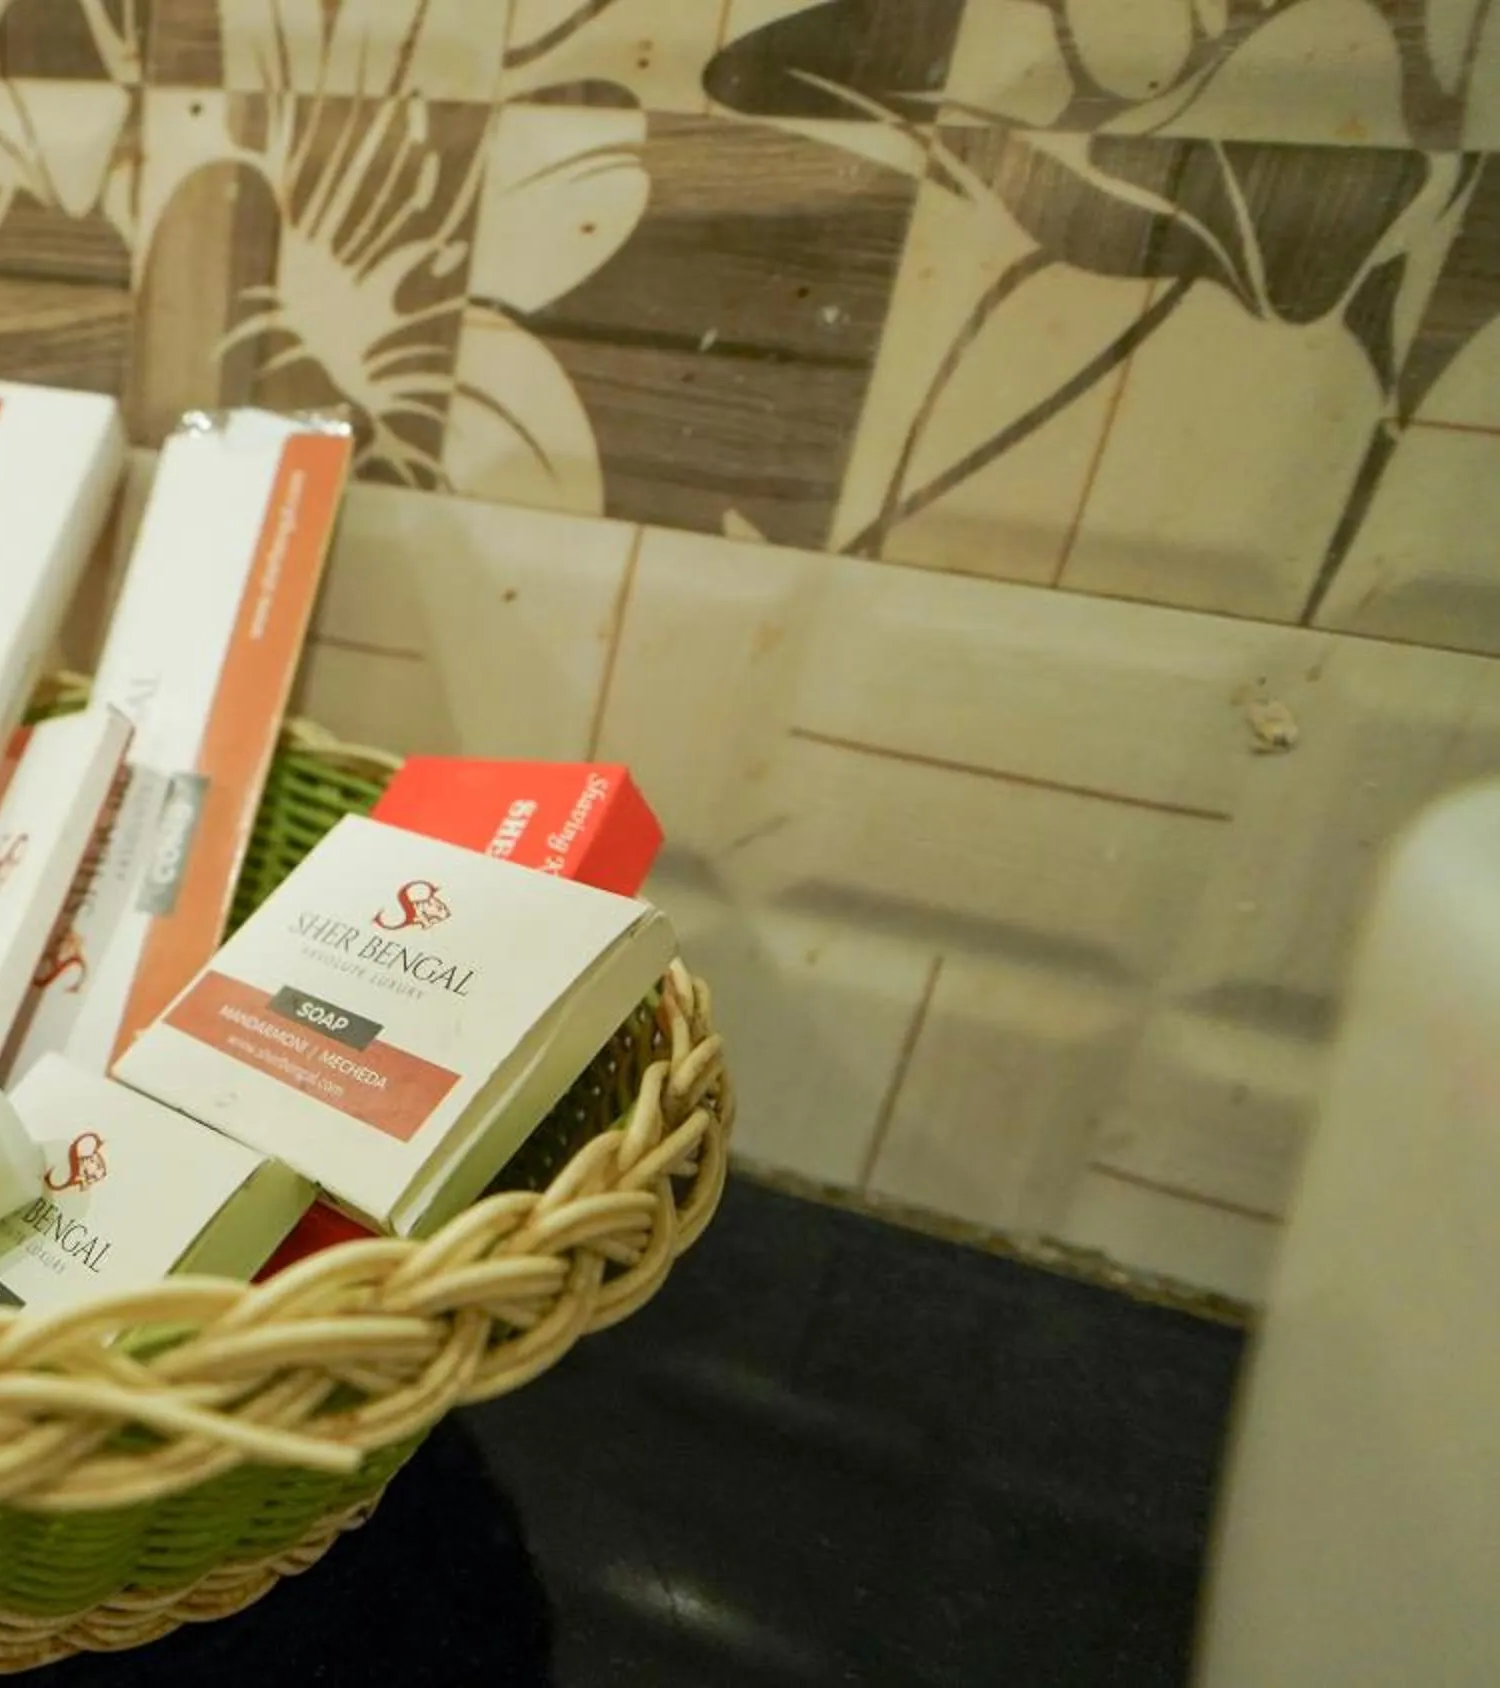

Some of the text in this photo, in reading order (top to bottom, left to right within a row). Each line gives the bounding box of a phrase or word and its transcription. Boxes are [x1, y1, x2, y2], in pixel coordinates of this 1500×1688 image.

[547, 771, 609, 855] Shaving
[290, 910, 475, 997] SHER BENGAL
[296, 1001, 349, 1032] SOAP
[23, 1197, 112, 1273] BENGAL
